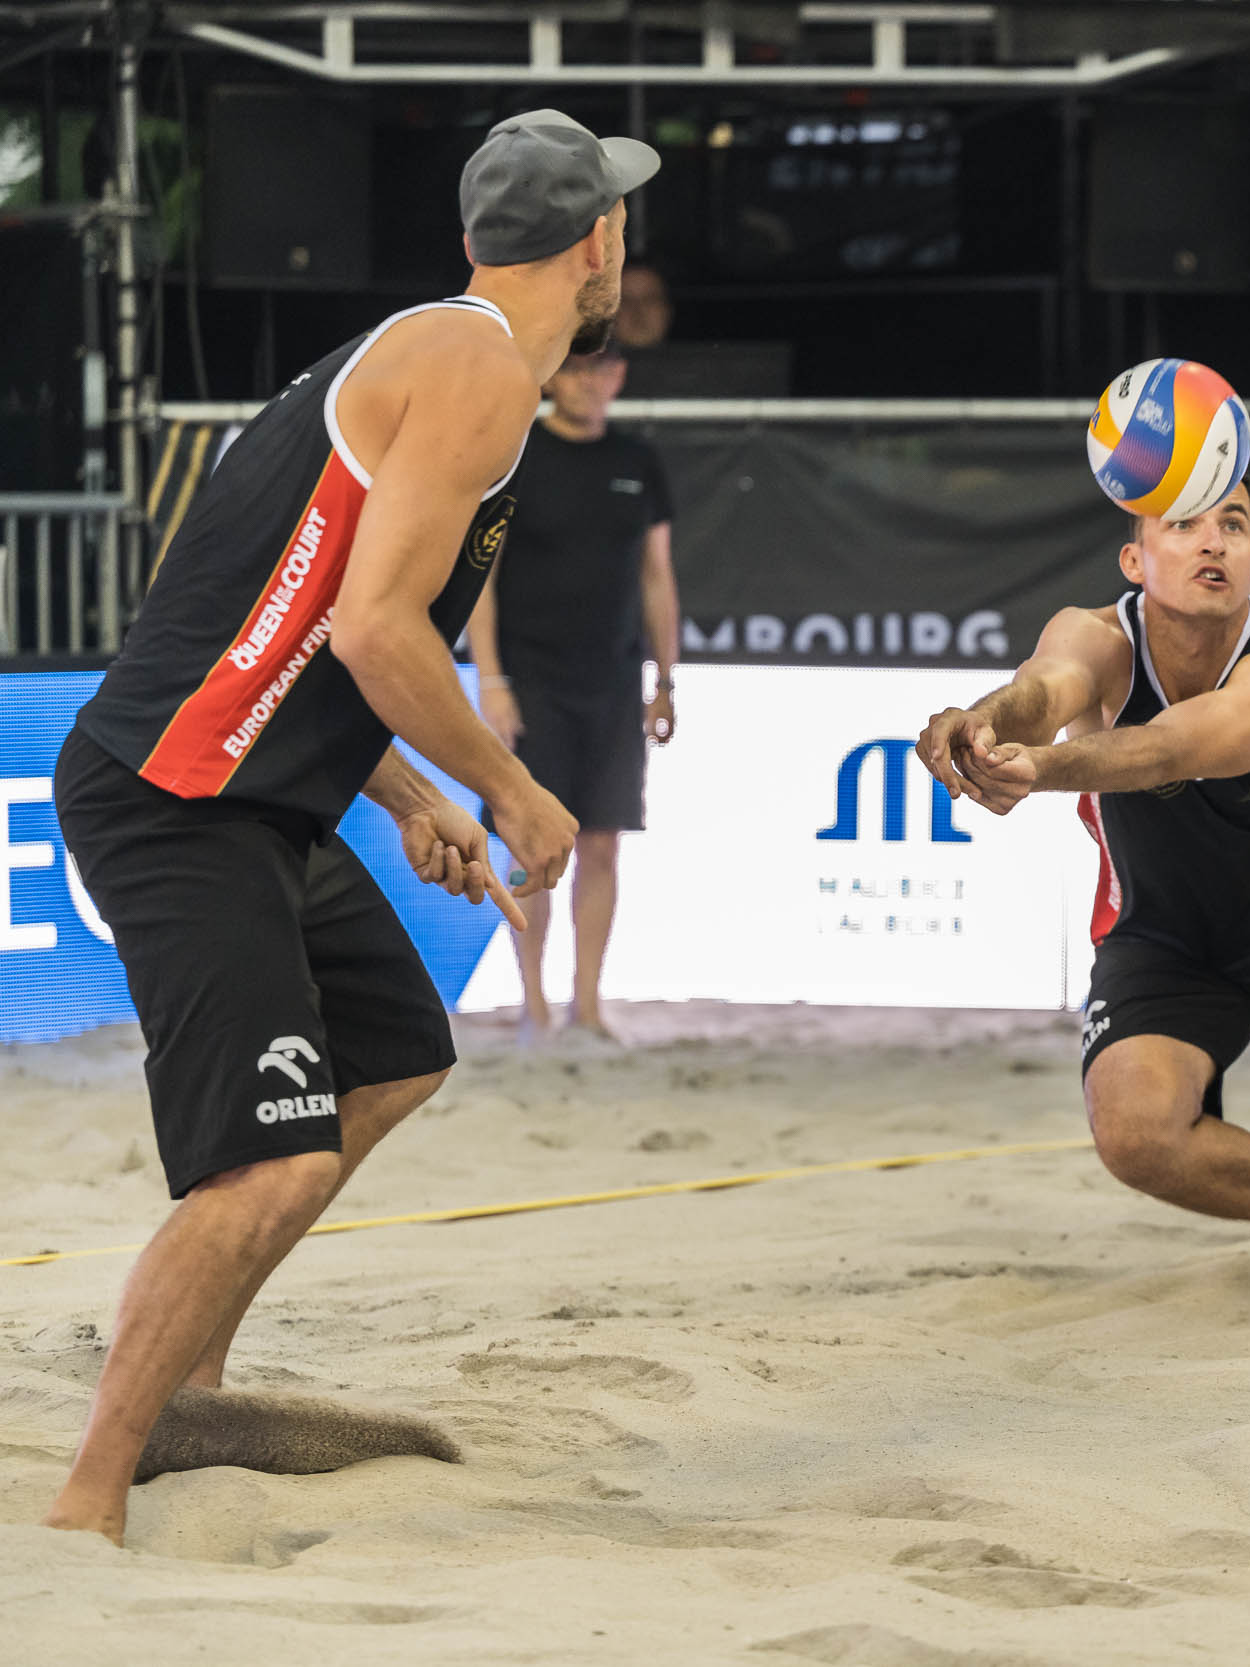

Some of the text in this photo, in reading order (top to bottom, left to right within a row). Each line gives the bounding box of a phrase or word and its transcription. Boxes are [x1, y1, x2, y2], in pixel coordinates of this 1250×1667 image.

[227, 592, 291, 671] QUEEN
[280, 506, 327, 591] COURT
[222, 653, 307, 759] EUROPEAN
[256, 1094, 337, 1124] ORLEN
